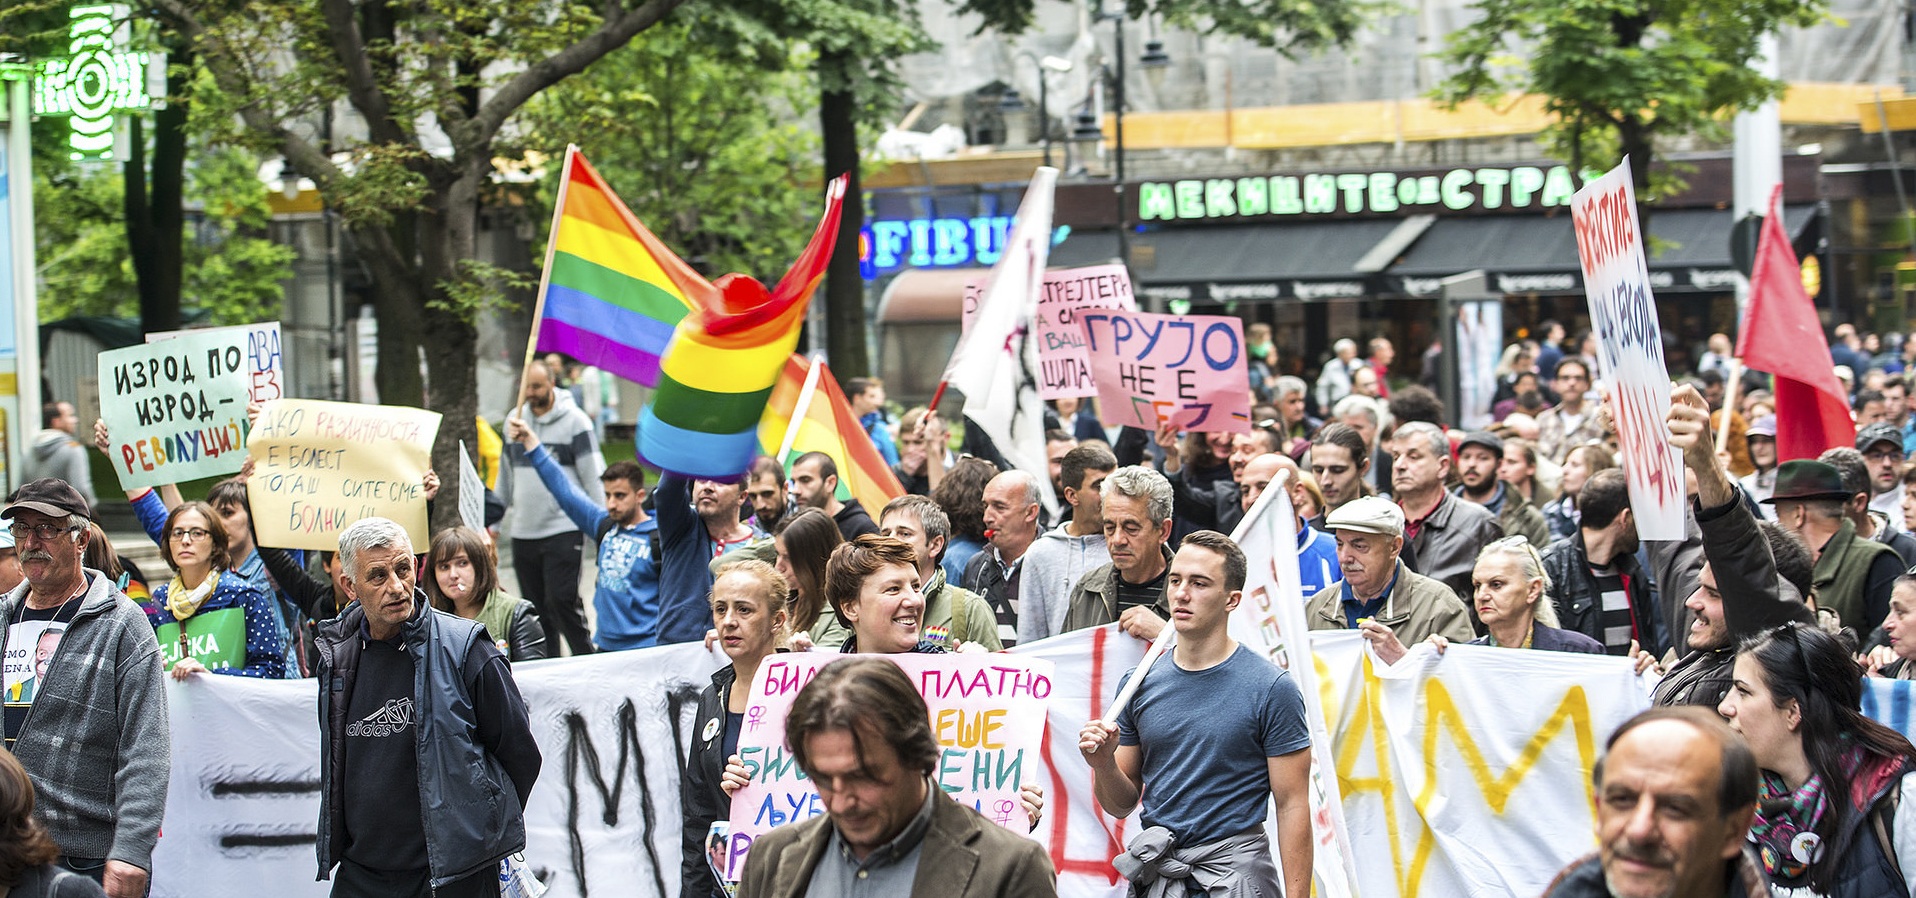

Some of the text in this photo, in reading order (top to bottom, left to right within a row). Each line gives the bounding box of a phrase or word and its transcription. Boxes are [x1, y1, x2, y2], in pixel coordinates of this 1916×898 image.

[1139, 172, 1399, 220] МЕКИЦИТЕ
[1441, 165, 1604, 210] СТРА
[873, 215, 1020, 268] FIBU
[249, 329, 283, 372] АВА
[1084, 315, 1239, 371] ГРУЈО
[114, 345, 241, 396] ИЗРОД ПО
[1120, 363, 1198, 400] НЕ Е
[135, 389, 214, 426] ИЗРОД
[262, 408, 421, 444] АКО РАЗЛИЧНОСТА
[1131, 396, 1213, 431] ГЕЈ
[268, 445, 346, 471] Е БОЛЕСТ
[259, 474, 425, 503] ТОГАШ СИТЕ СМЕ
[289, 500, 347, 534] БОЛНИ
[928, 708, 1009, 749] ЕШЕ
[938, 748, 1024, 793] ЕНИ
